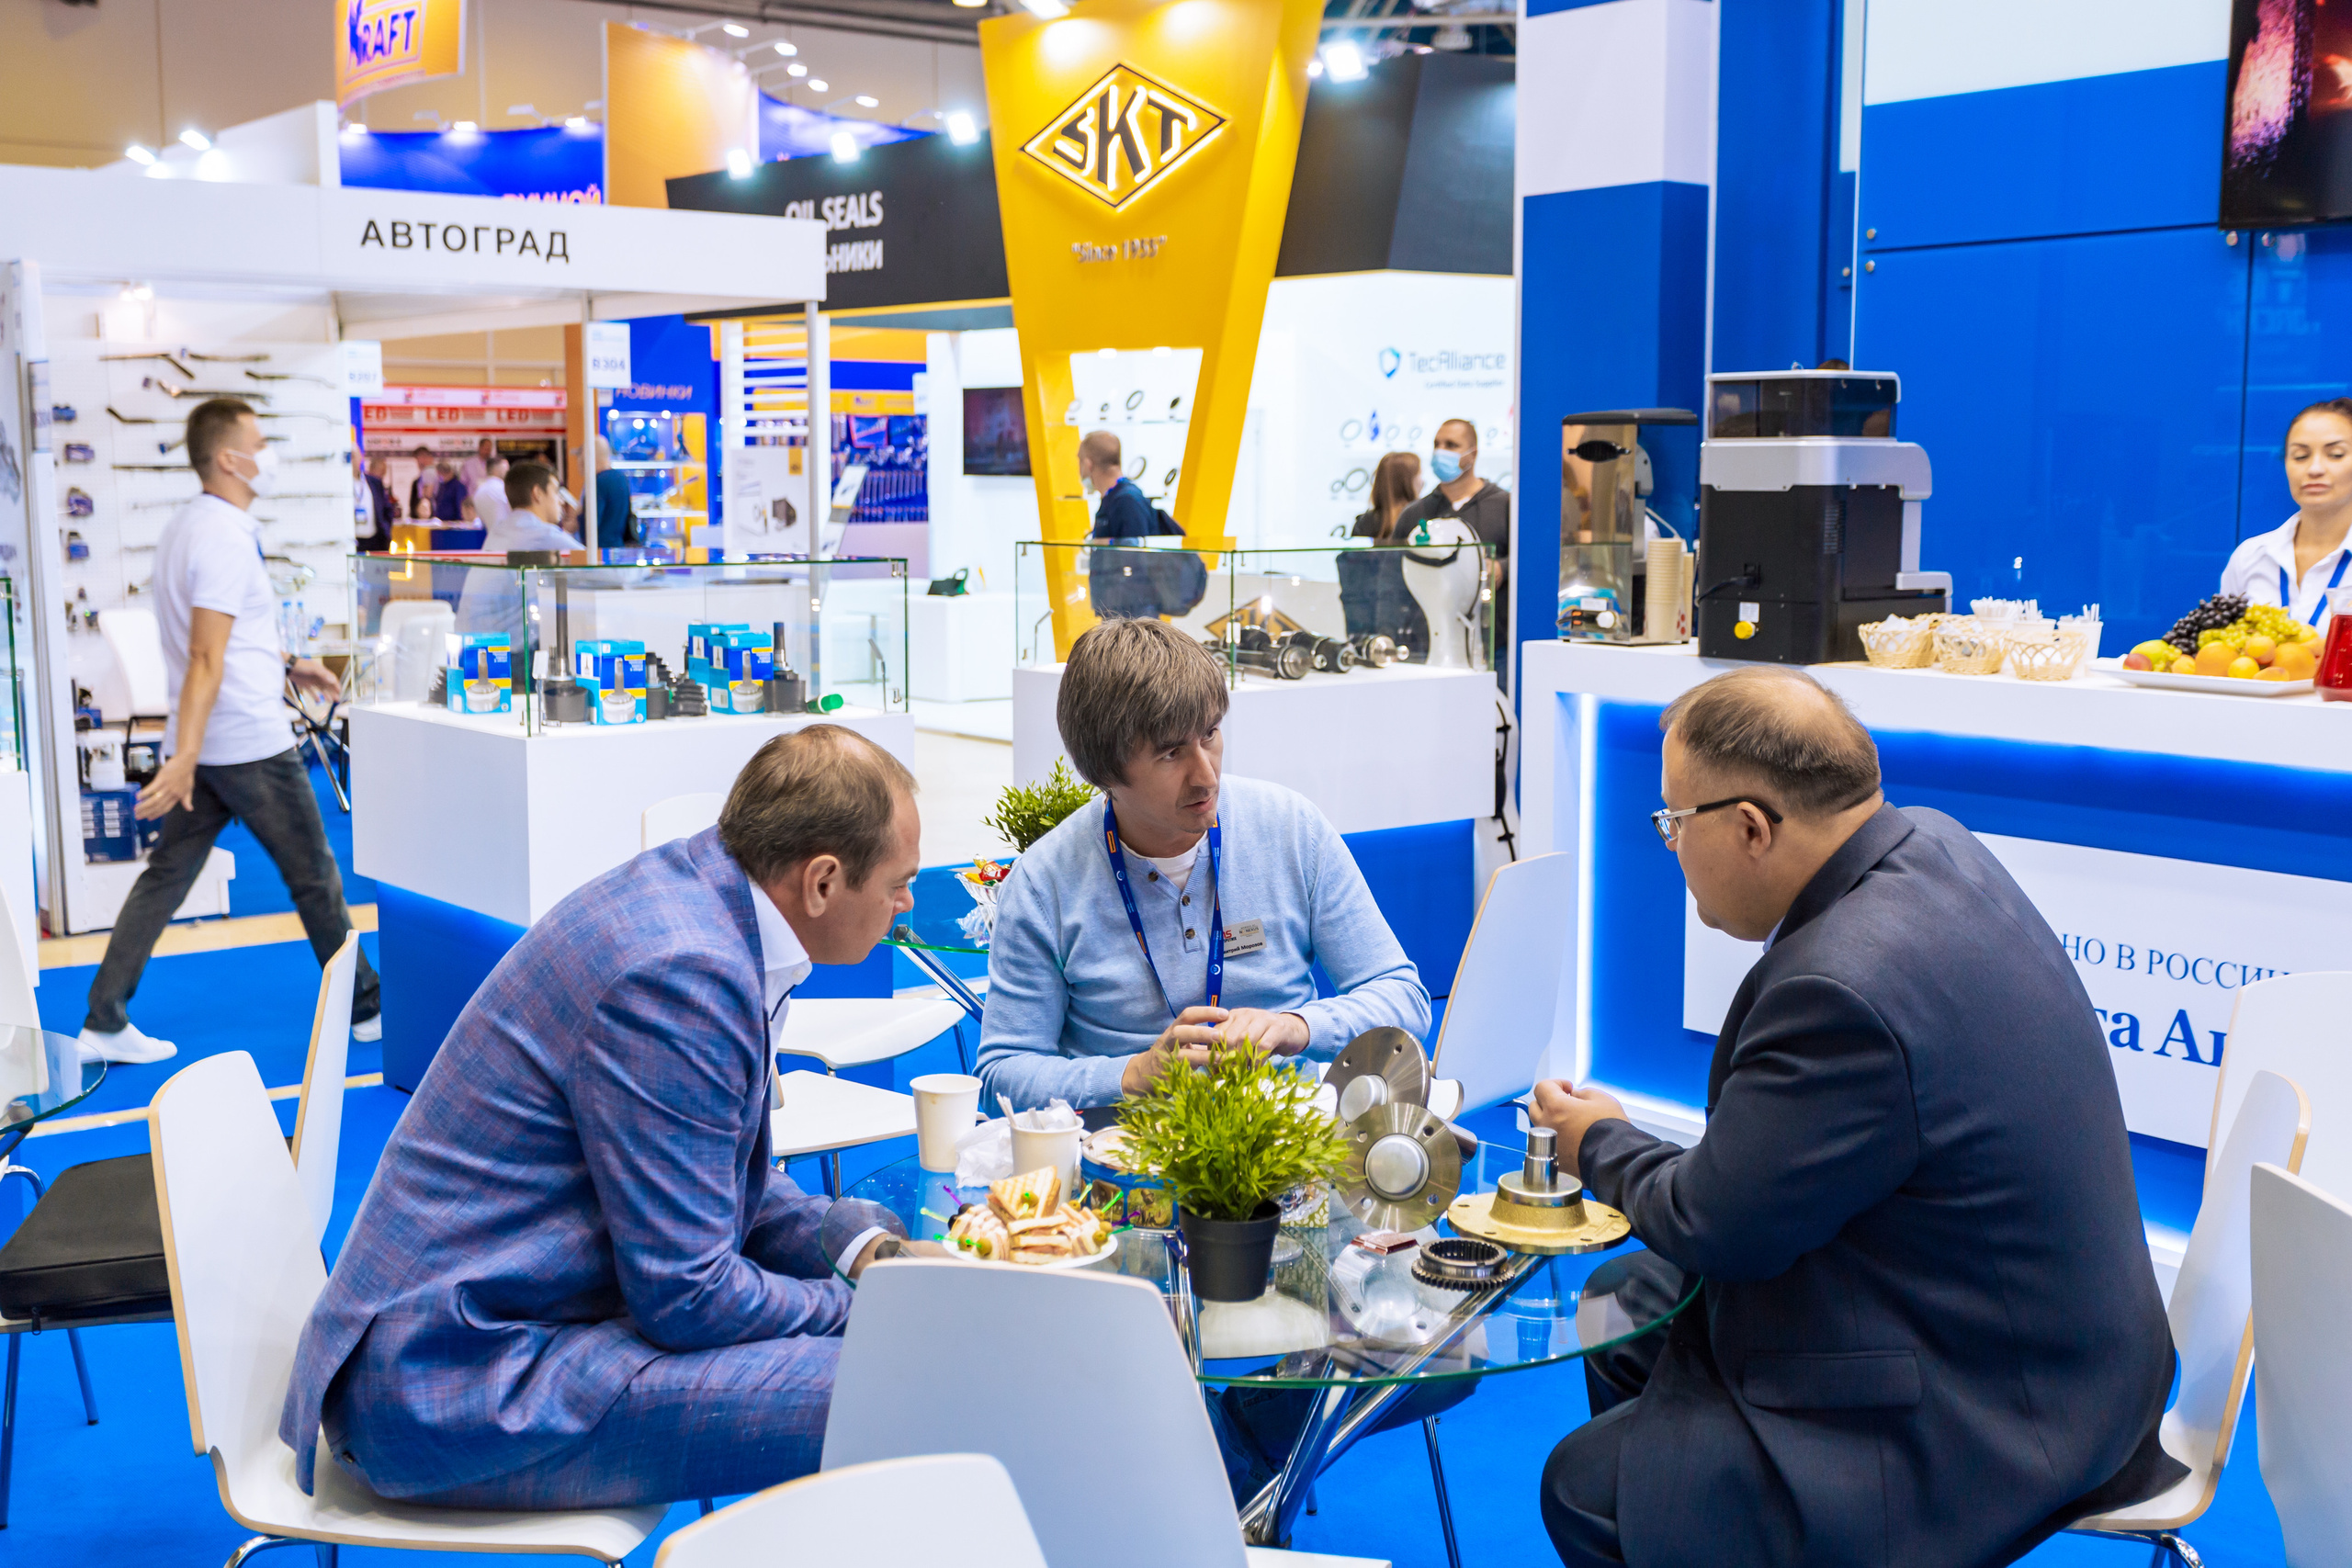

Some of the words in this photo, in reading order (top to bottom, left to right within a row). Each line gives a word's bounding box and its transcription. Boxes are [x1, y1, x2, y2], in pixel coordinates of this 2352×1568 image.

[1053, 84, 1198, 192] SKT
[821, 190, 884, 231] SEALS
[360, 220, 571, 265] АВТОГРАД
[1408, 350, 1507, 373] TecAlliance
[2116, 943, 2136, 971] В
[2145, 948, 2290, 989] РОССИ
